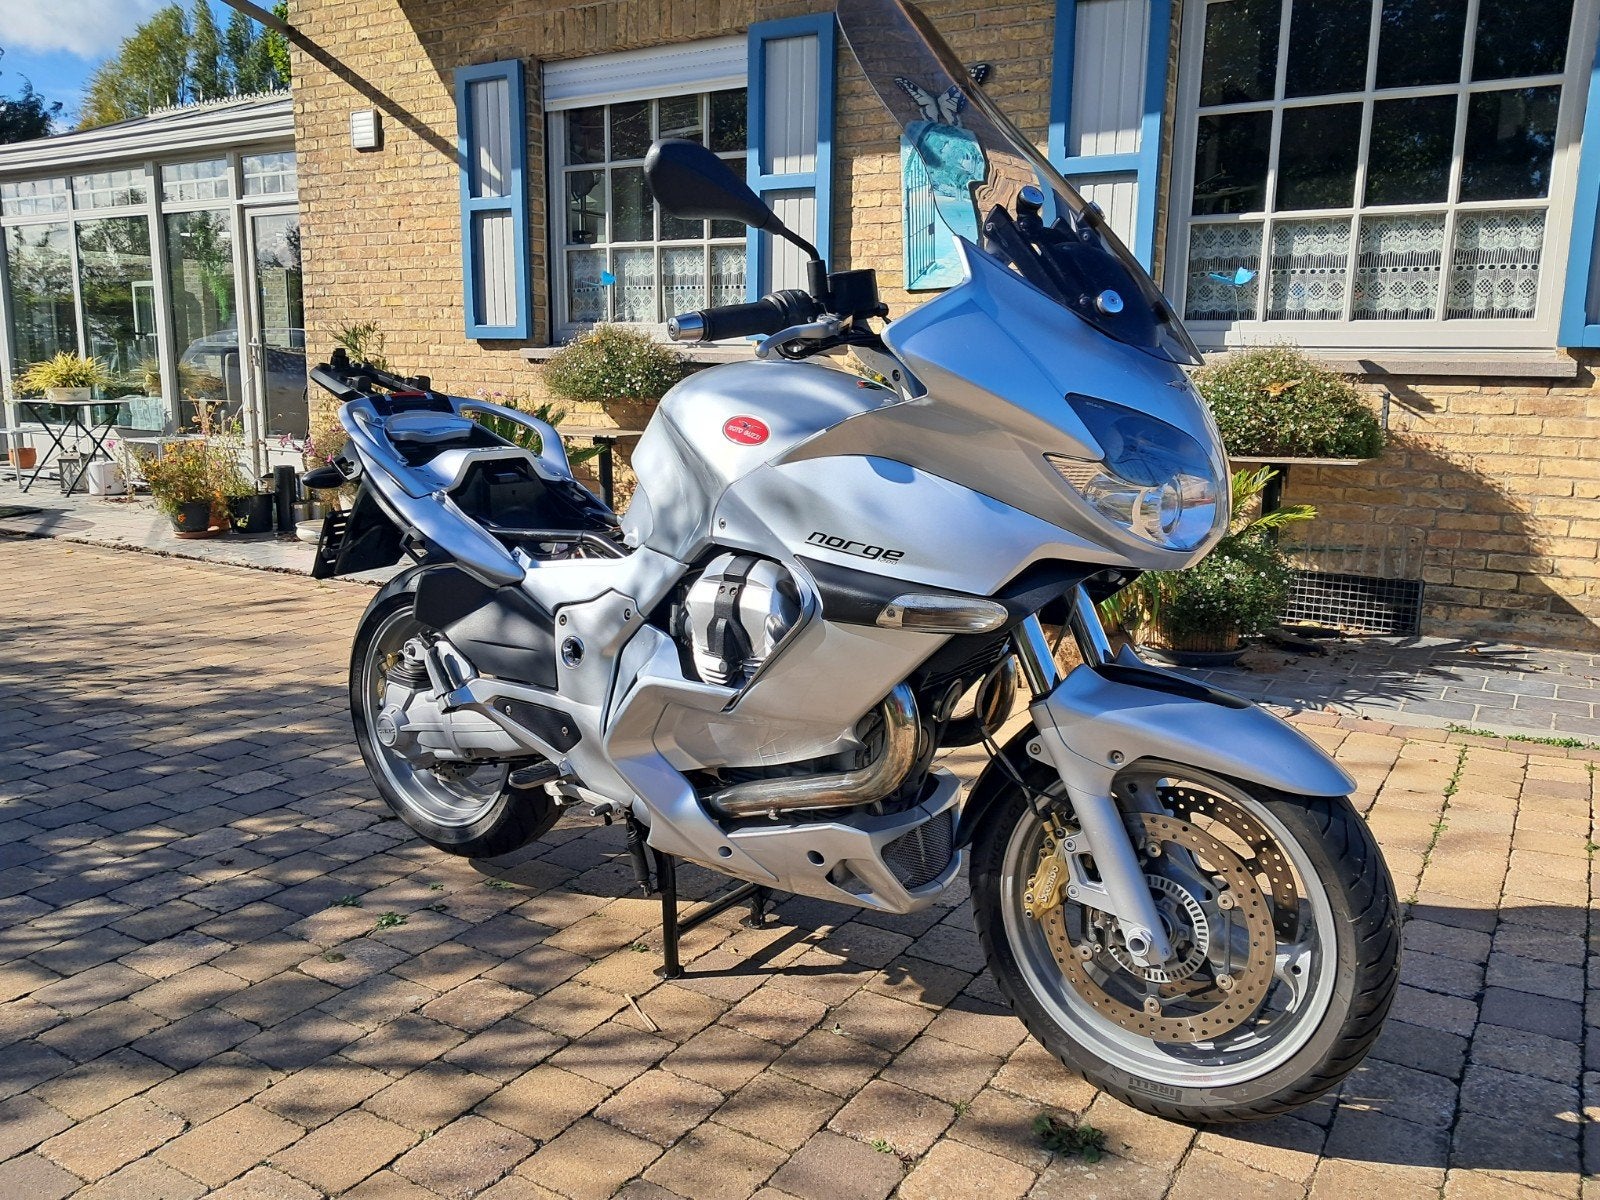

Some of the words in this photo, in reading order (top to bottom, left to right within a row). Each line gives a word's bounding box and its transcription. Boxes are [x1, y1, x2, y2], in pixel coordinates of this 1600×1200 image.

[727, 424, 744, 434] MOTO
[743, 430, 762, 440] GUZZI
[804, 531, 905, 561] norge
[1128, 1076, 1182, 1103] PIRELLI
